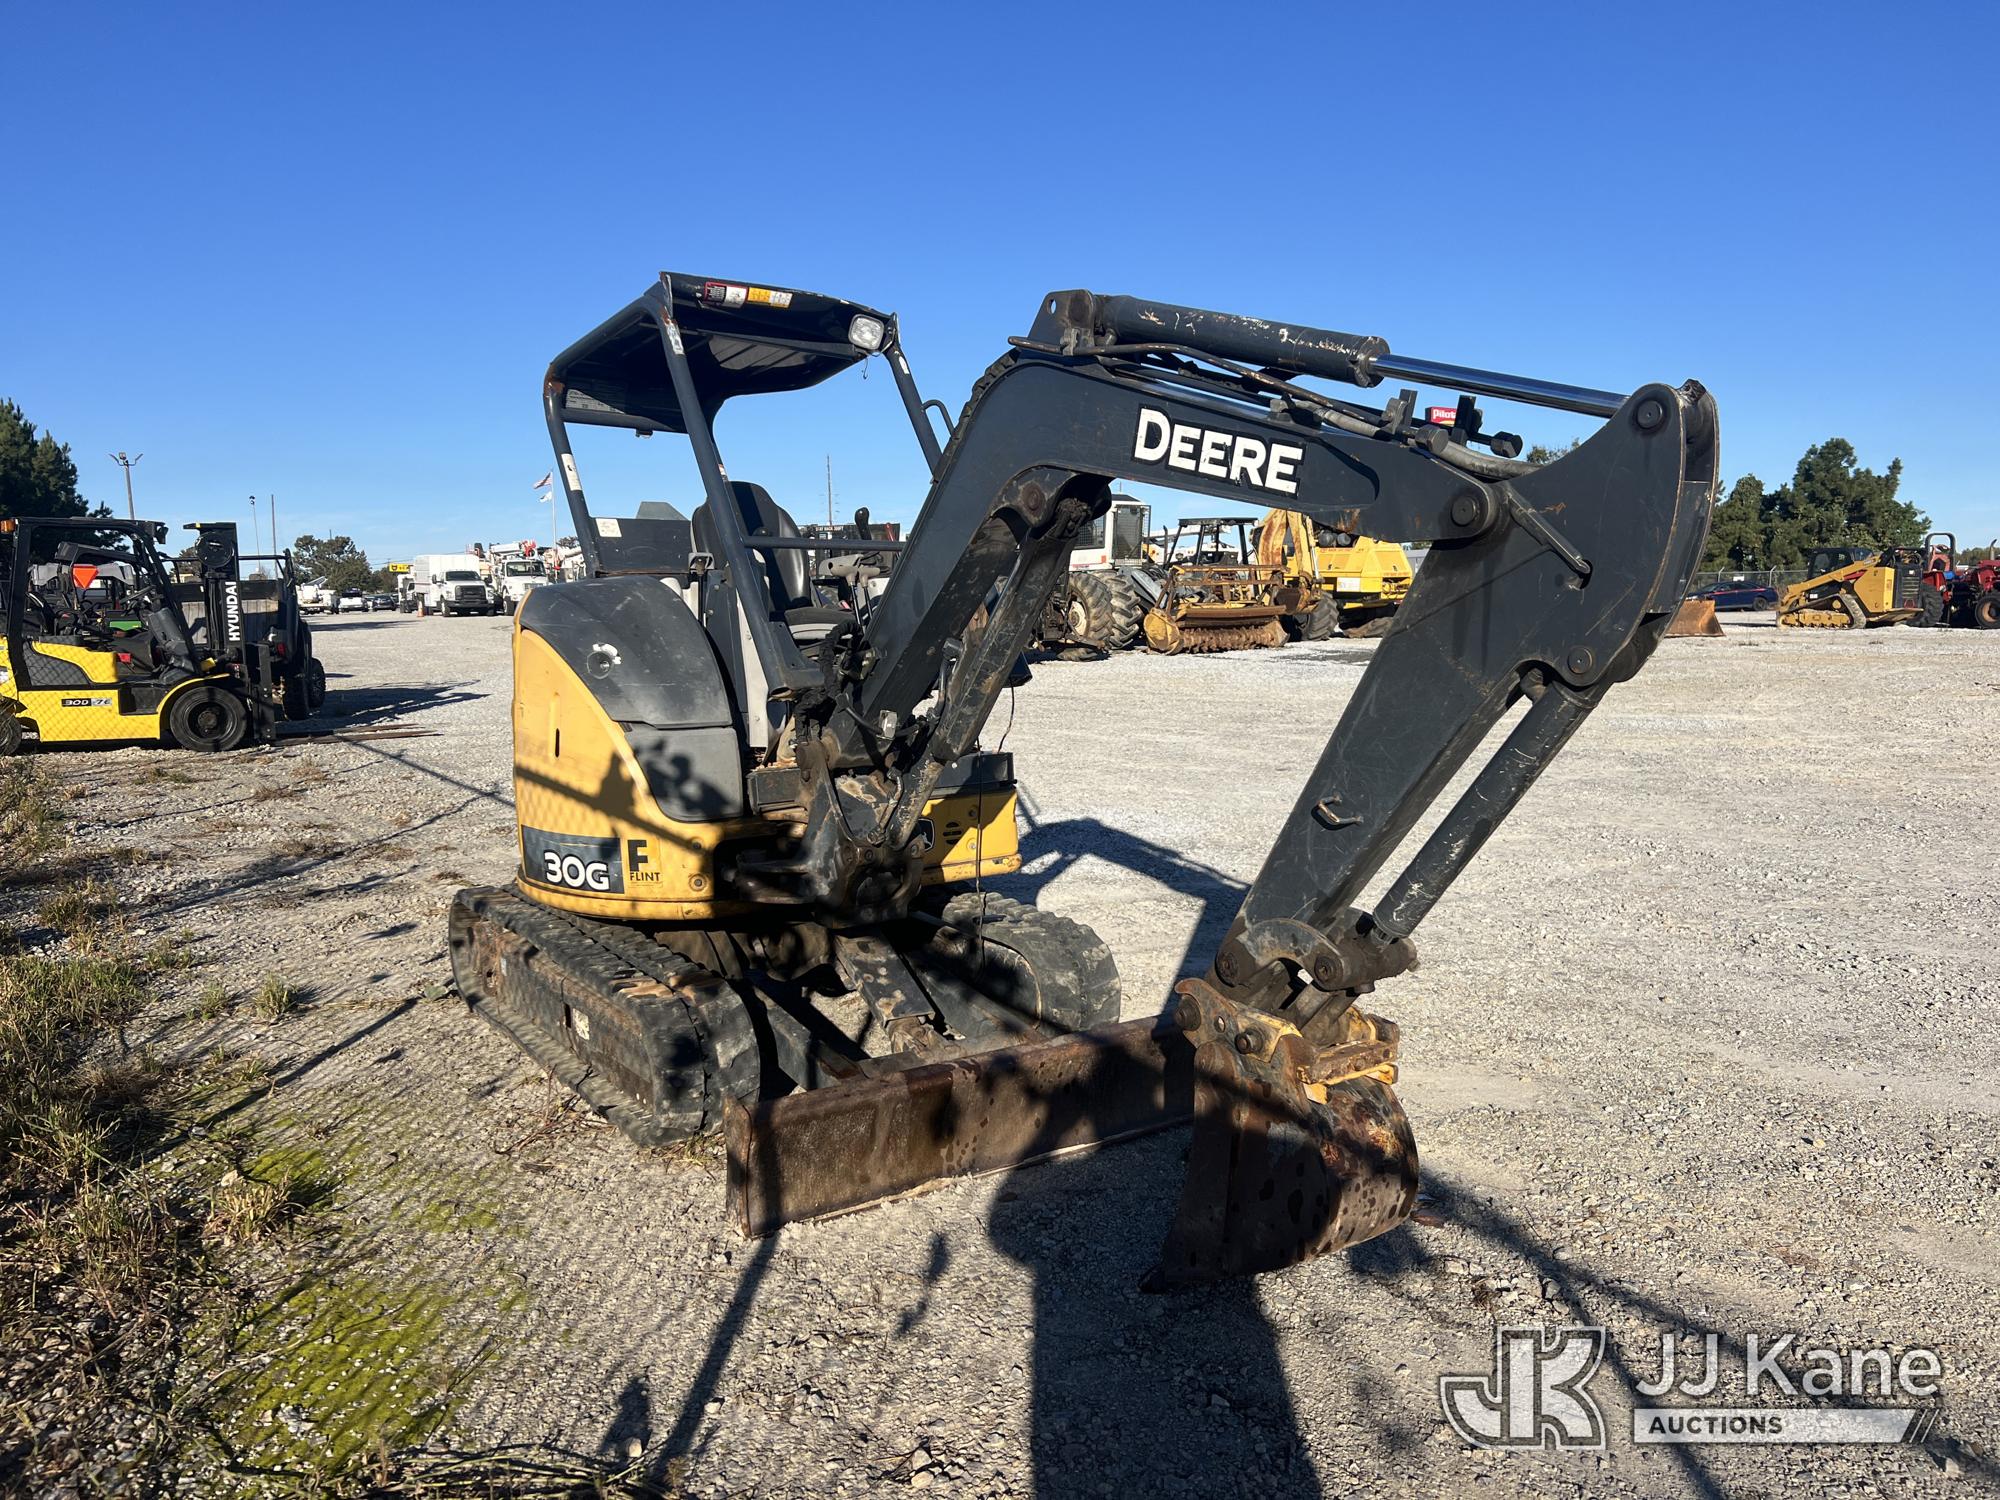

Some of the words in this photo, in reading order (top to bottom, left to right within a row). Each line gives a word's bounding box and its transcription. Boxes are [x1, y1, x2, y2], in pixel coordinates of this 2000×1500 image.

[1432, 409, 1457, 420] Pilot
[1134, 408, 1303, 494] DEERE
[225, 581, 240, 641] HYUNDAI
[544, 850, 610, 891] 30G
[629, 872, 661, 882] FLINT
